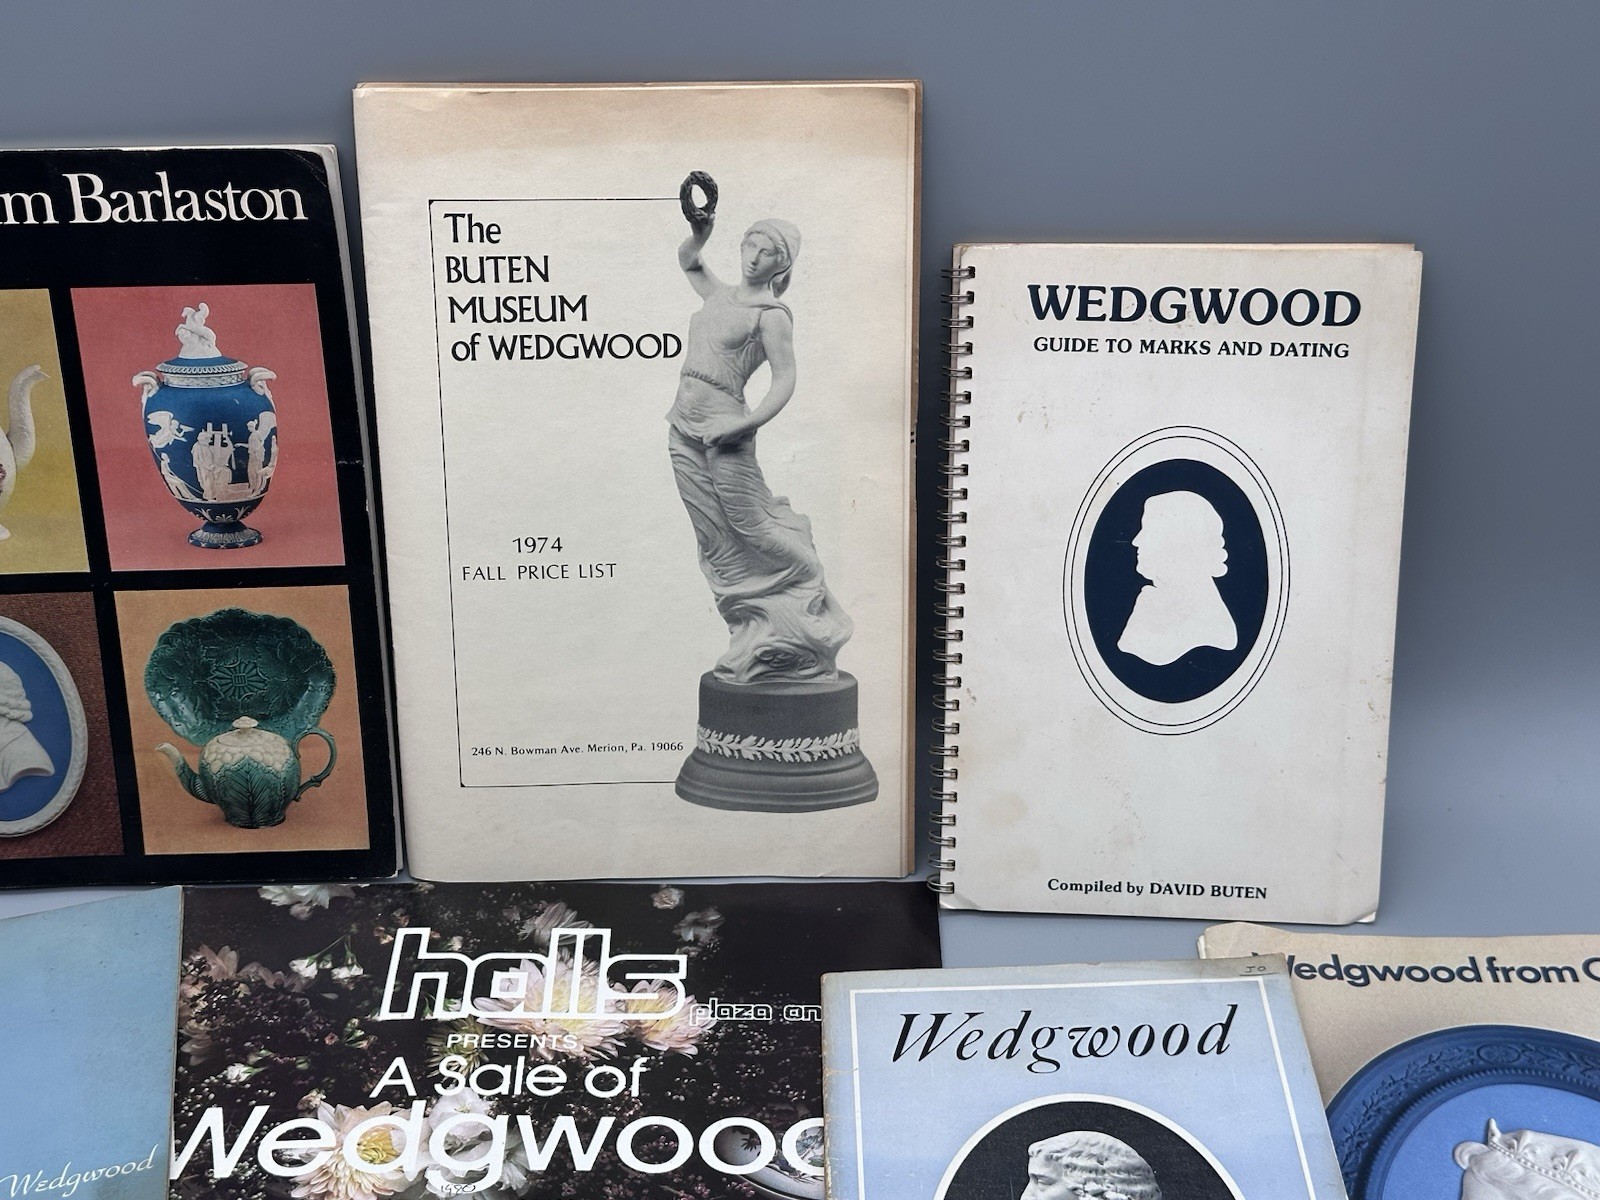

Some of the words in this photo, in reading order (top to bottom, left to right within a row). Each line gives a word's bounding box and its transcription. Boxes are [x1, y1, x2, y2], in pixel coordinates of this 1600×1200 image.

[62, 171, 309, 224] Barlaston
[443, 213, 502, 244] The
[445, 255, 550, 284] BUTEN
[447, 294, 588, 324] MUSEUM
[1027, 284, 1362, 327] WEDGWOOD
[451, 333, 481, 362] of
[488, 333, 682, 361] WEDGWOOD
[1033, 336, 1099, 354] GUIDE
[1105, 338, 1132, 354] TO
[1139, 339, 1211, 356] MARKS
[1217, 341, 1262, 356] AND
[1269, 342, 1350, 359] DATING
[512, 536, 563, 554] 1974
[461, 566, 506, 581] FALL
[517, 564, 570, 580] PRICE
[579, 563, 617, 579] LIST
[471, 746, 492, 756] 246
[495, 746, 507, 756] N.
[511, 746, 557, 756] Bowman
[560, 745, 584, 754] Ave.
[587, 743, 628, 754] Merion,
[631, 742, 647, 752] Pa.
[650, 741, 684, 752] 19066
[1047, 878, 1122, 895] Compiled
[1126, 882, 1144, 896] by
[1150, 882, 1205, 896] DAVID
[1210, 885, 1267, 899] BUTEN
[379, 927, 688, 1021] halls
[1487, 956, 1579, 983] from
[689, 997, 773, 1026] plaza
[446, 1033, 578, 1049] PRESENTS
[892, 1005, 1239, 1074] Wedgwood
[369, 1056, 416, 1098] A
[434, 1055, 567, 1097] Sale
[584, 1056, 651, 1098] of
[0, 1144, 159, 1198] Wedgwood
